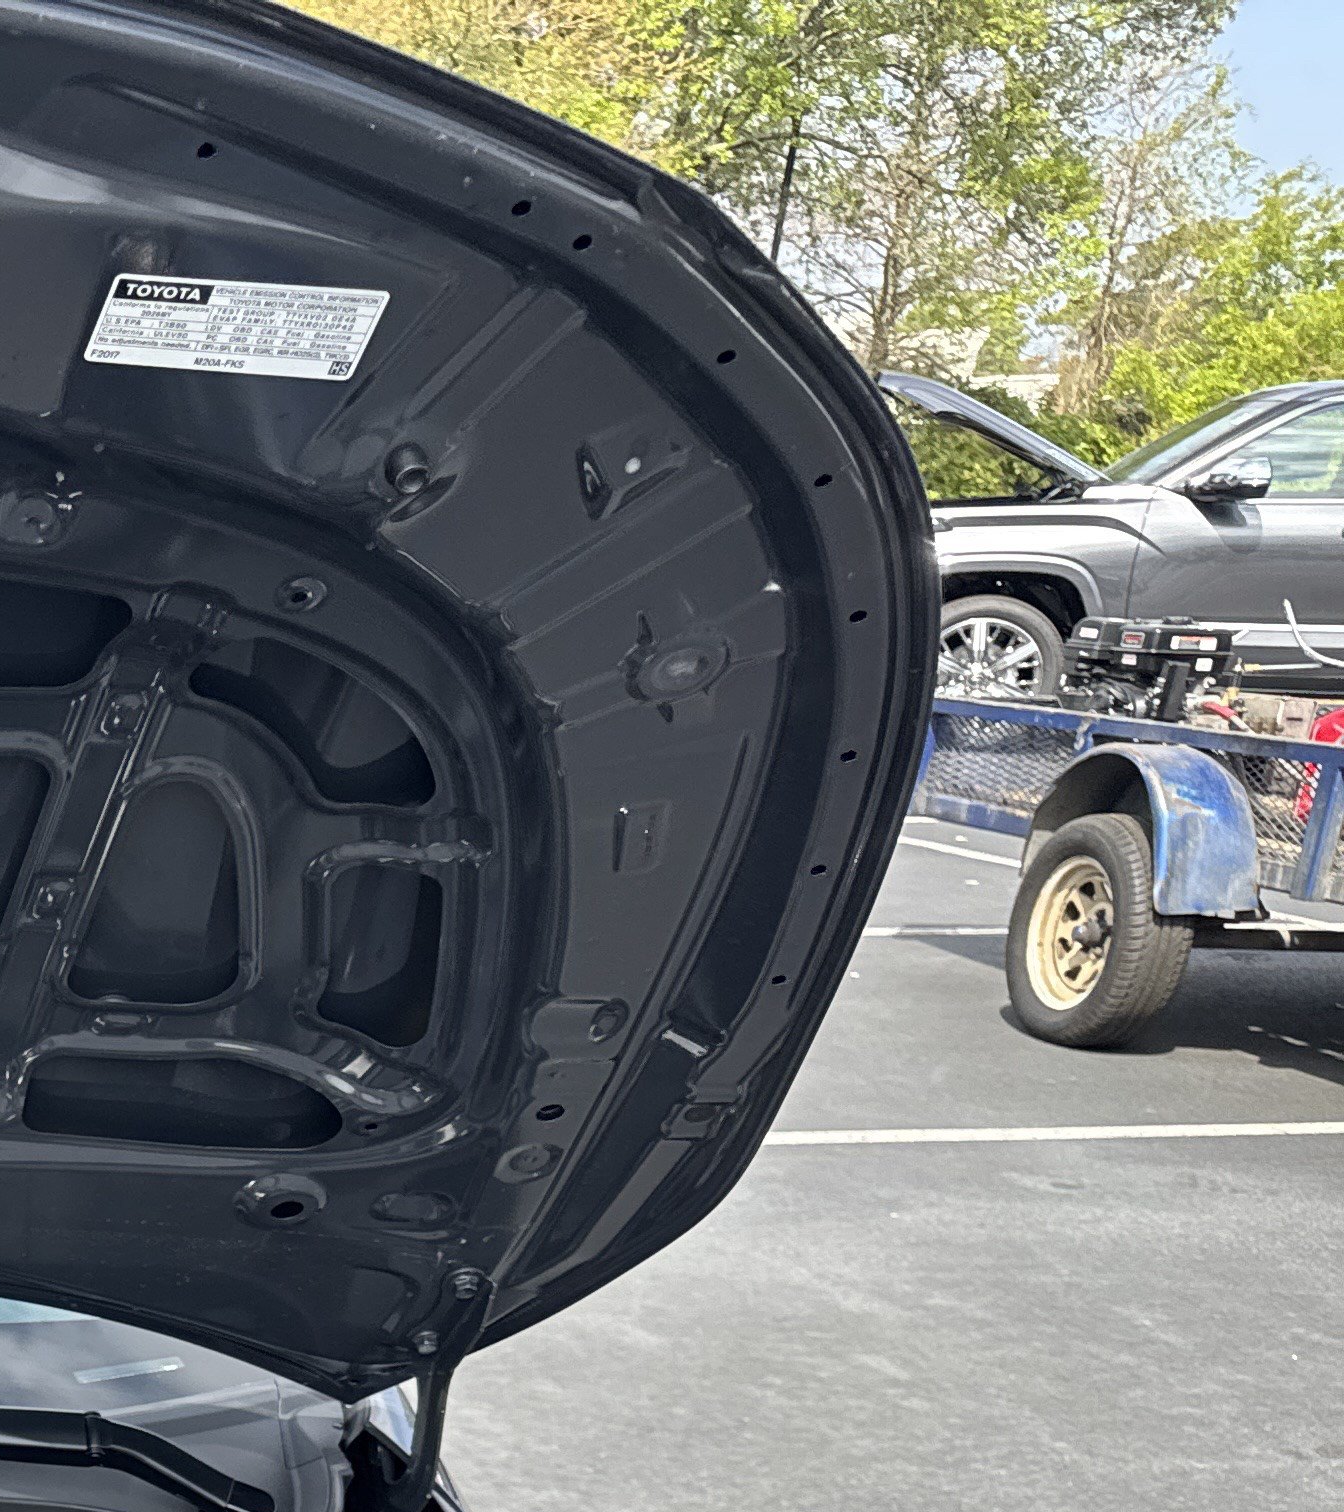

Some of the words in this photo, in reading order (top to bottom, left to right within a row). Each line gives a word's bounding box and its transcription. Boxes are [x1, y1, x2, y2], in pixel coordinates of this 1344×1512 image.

[126, 283, 201, 301] TOYOTA
[228, 298, 262, 306] TOYOTA
[263, 300, 295, 308] MOTOR
[295, 303, 358, 313] CORPORATION
[211, 314, 238, 322] EVAP
[242, 309, 275, 317] GROUP
[101, 326, 144, 335] California
[308, 342, 347, 350] Gasoline
[313, 332, 352, 340] Gasoline
[89, 348, 120, 359] F2017
[193, 357, 245, 368] M20A-FKS
[328, 362, 350, 374] HS
